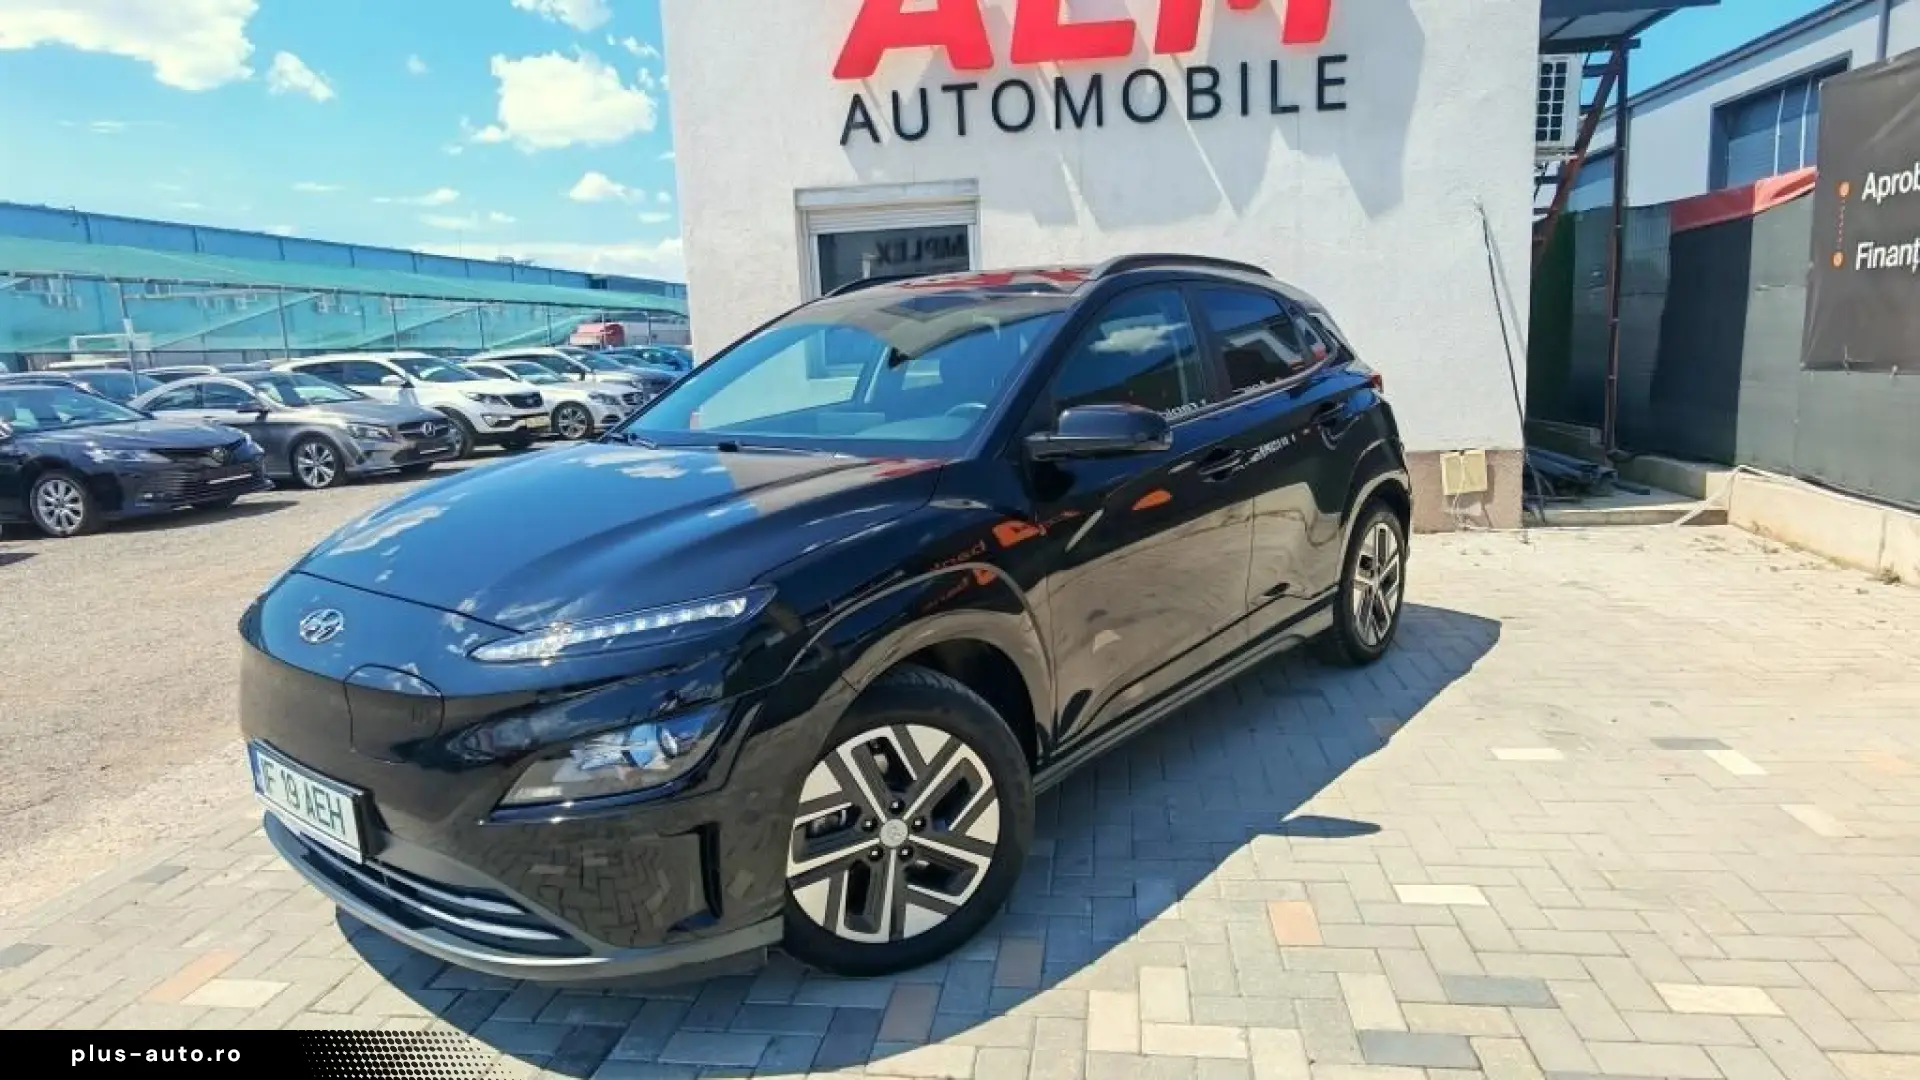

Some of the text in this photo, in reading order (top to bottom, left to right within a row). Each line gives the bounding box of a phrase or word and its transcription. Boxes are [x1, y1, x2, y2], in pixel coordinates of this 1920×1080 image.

[839, 54, 1348, 146] AUTOMOBILE
[281, 768, 301, 810] 19
[303, 781, 346, 836] AEH
